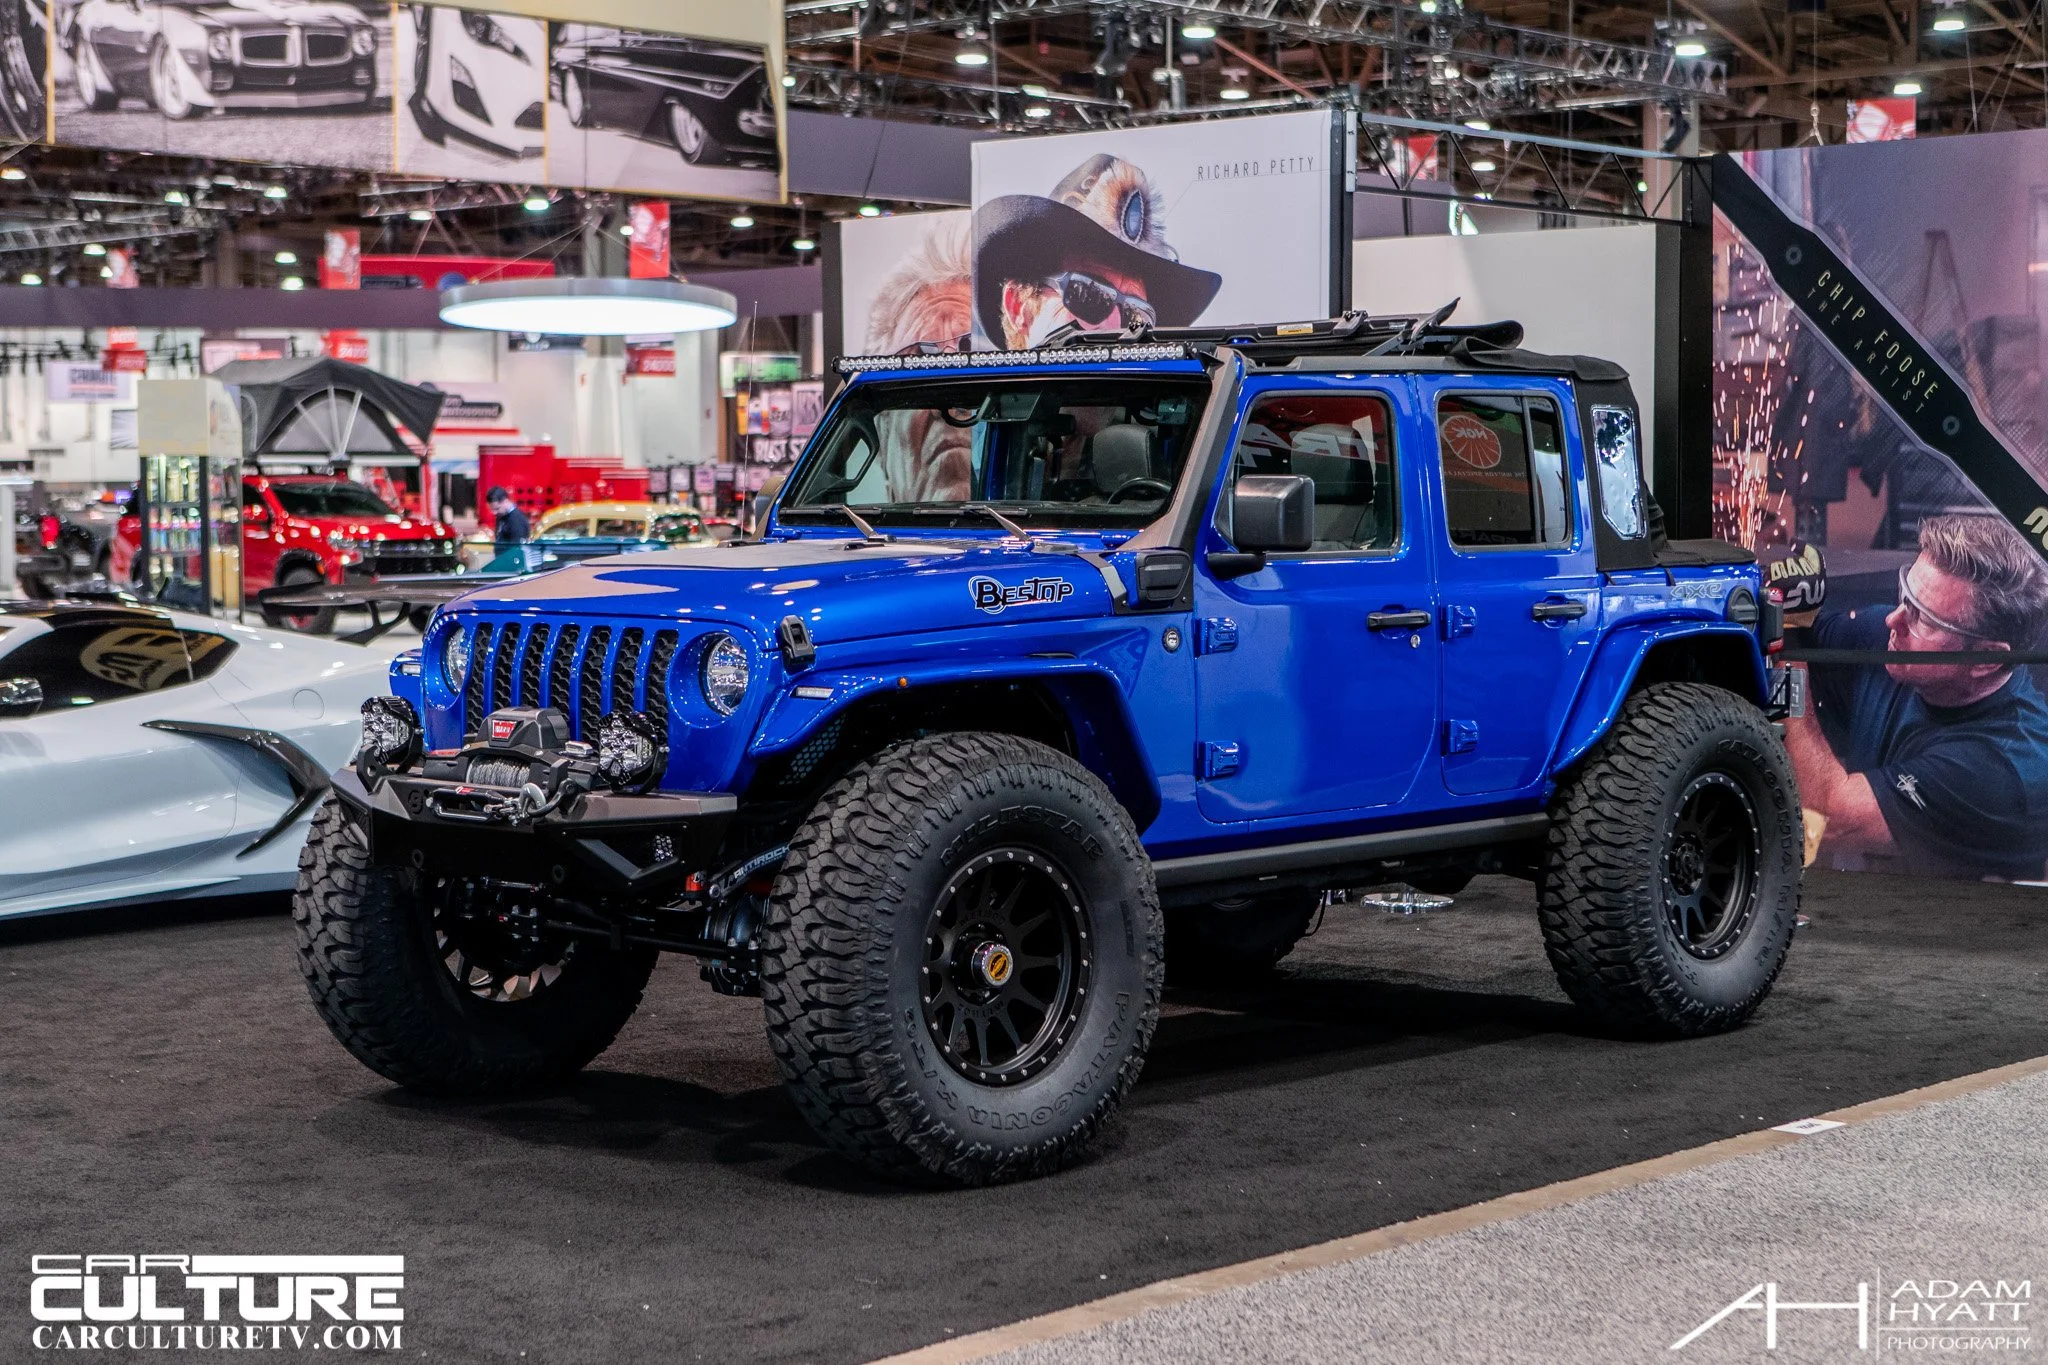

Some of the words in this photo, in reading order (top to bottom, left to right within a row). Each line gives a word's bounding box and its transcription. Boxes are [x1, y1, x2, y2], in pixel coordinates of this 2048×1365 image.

[1197, 161, 1259, 180] RICHARD
[1270, 156, 1314, 174] PETTY
[1807, 287, 1841, 326] THE
[1853, 339, 1925, 414] ARTIST
[1817, 269, 1866, 321] CHIP
[1873, 328, 1939, 400] FOOSE
[940, 805, 1104, 868] MILESTAR
[967, 991, 1130, 1131] PATAGONIA
